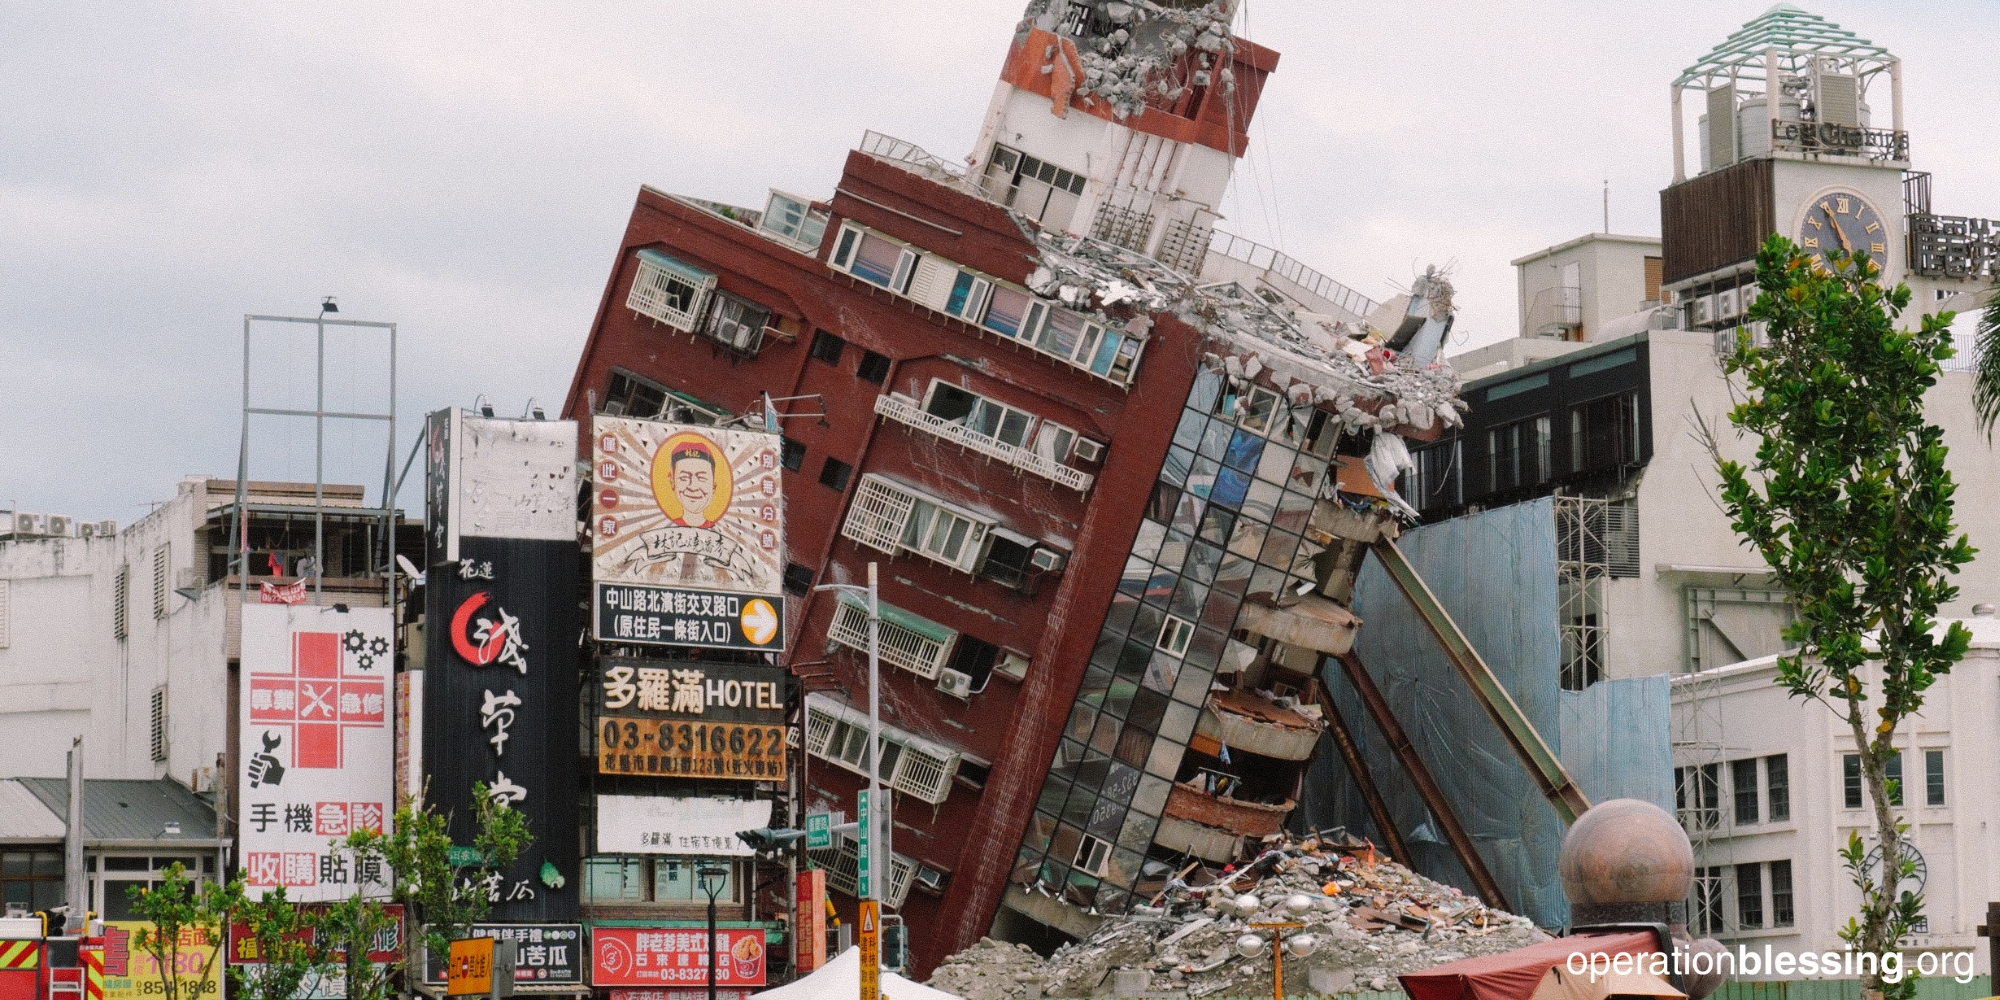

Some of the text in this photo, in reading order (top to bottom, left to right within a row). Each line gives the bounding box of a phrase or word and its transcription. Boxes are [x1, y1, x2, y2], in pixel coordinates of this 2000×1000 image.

[459, 558, 494, 579] 花蓮
[606, 587, 739, 618] 中山路北濱街交叉路口
[613, 614, 731, 643] (原住民一條街入口)
[251, 688, 383, 715] 專業 急修
[603, 666, 784, 714] 多羅滿 HOTEL
[604, 720, 782, 757] 03-8316622
[250, 803, 381, 834] 手機急診
[250, 853, 382, 885] 收購貼膜
[660, 968, 730, 981] 03-832730
